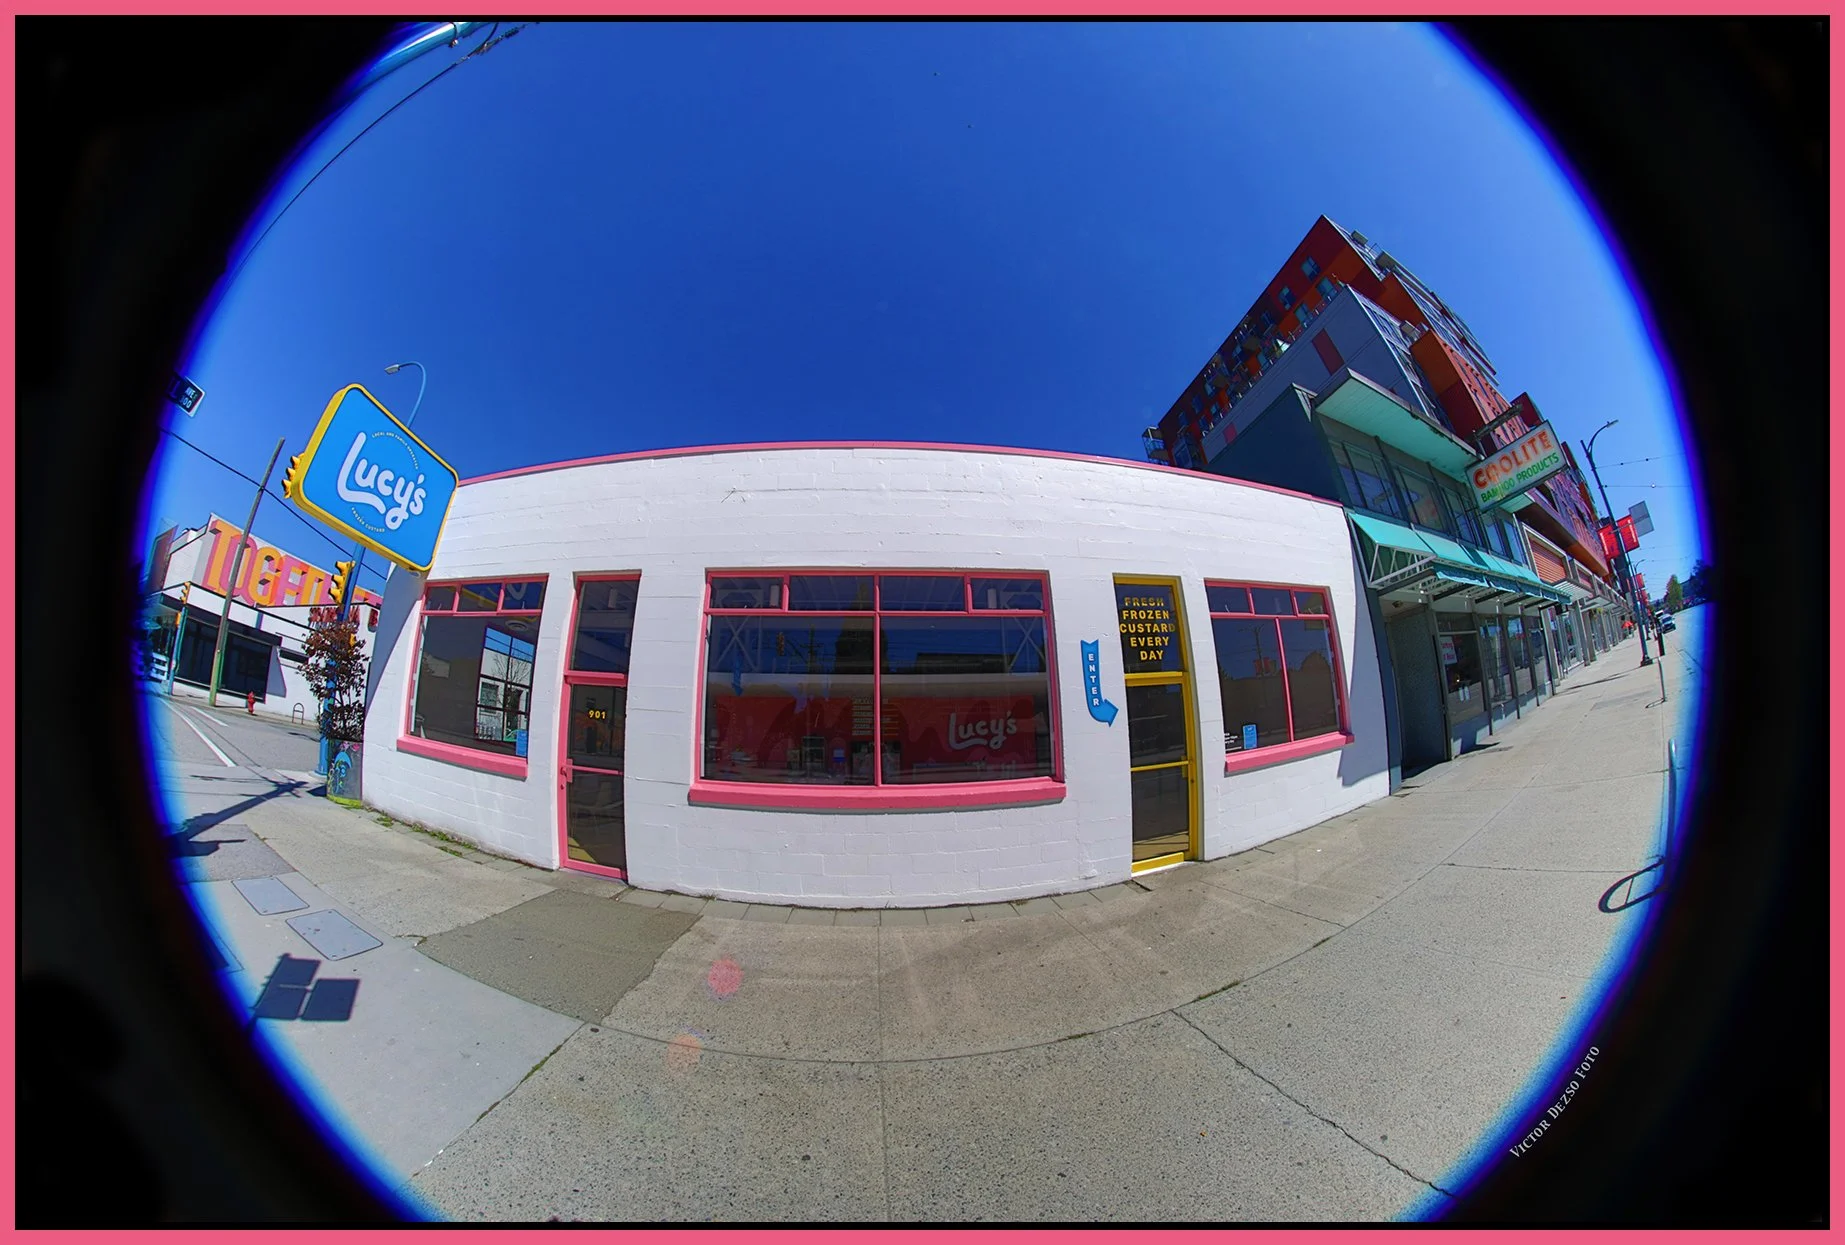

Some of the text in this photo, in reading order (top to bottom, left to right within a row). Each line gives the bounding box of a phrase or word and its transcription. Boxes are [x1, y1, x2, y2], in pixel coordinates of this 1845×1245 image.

[1516, 452, 1560, 483] PRODUCTS
[337, 431, 427, 530] Lucy's
[1124, 597, 1165, 607] FRESH
[1122, 610, 1170, 620] FROZEN
[1119, 623, 1176, 633] CUSTARD
[1130, 636, 1170, 647] EVERY
[1140, 650, 1164, 661] DAY
[1088, 653, 1100, 706] ENTER
[589, 710, 607, 719] 901
[949, 710, 1018, 750] Lucy's
